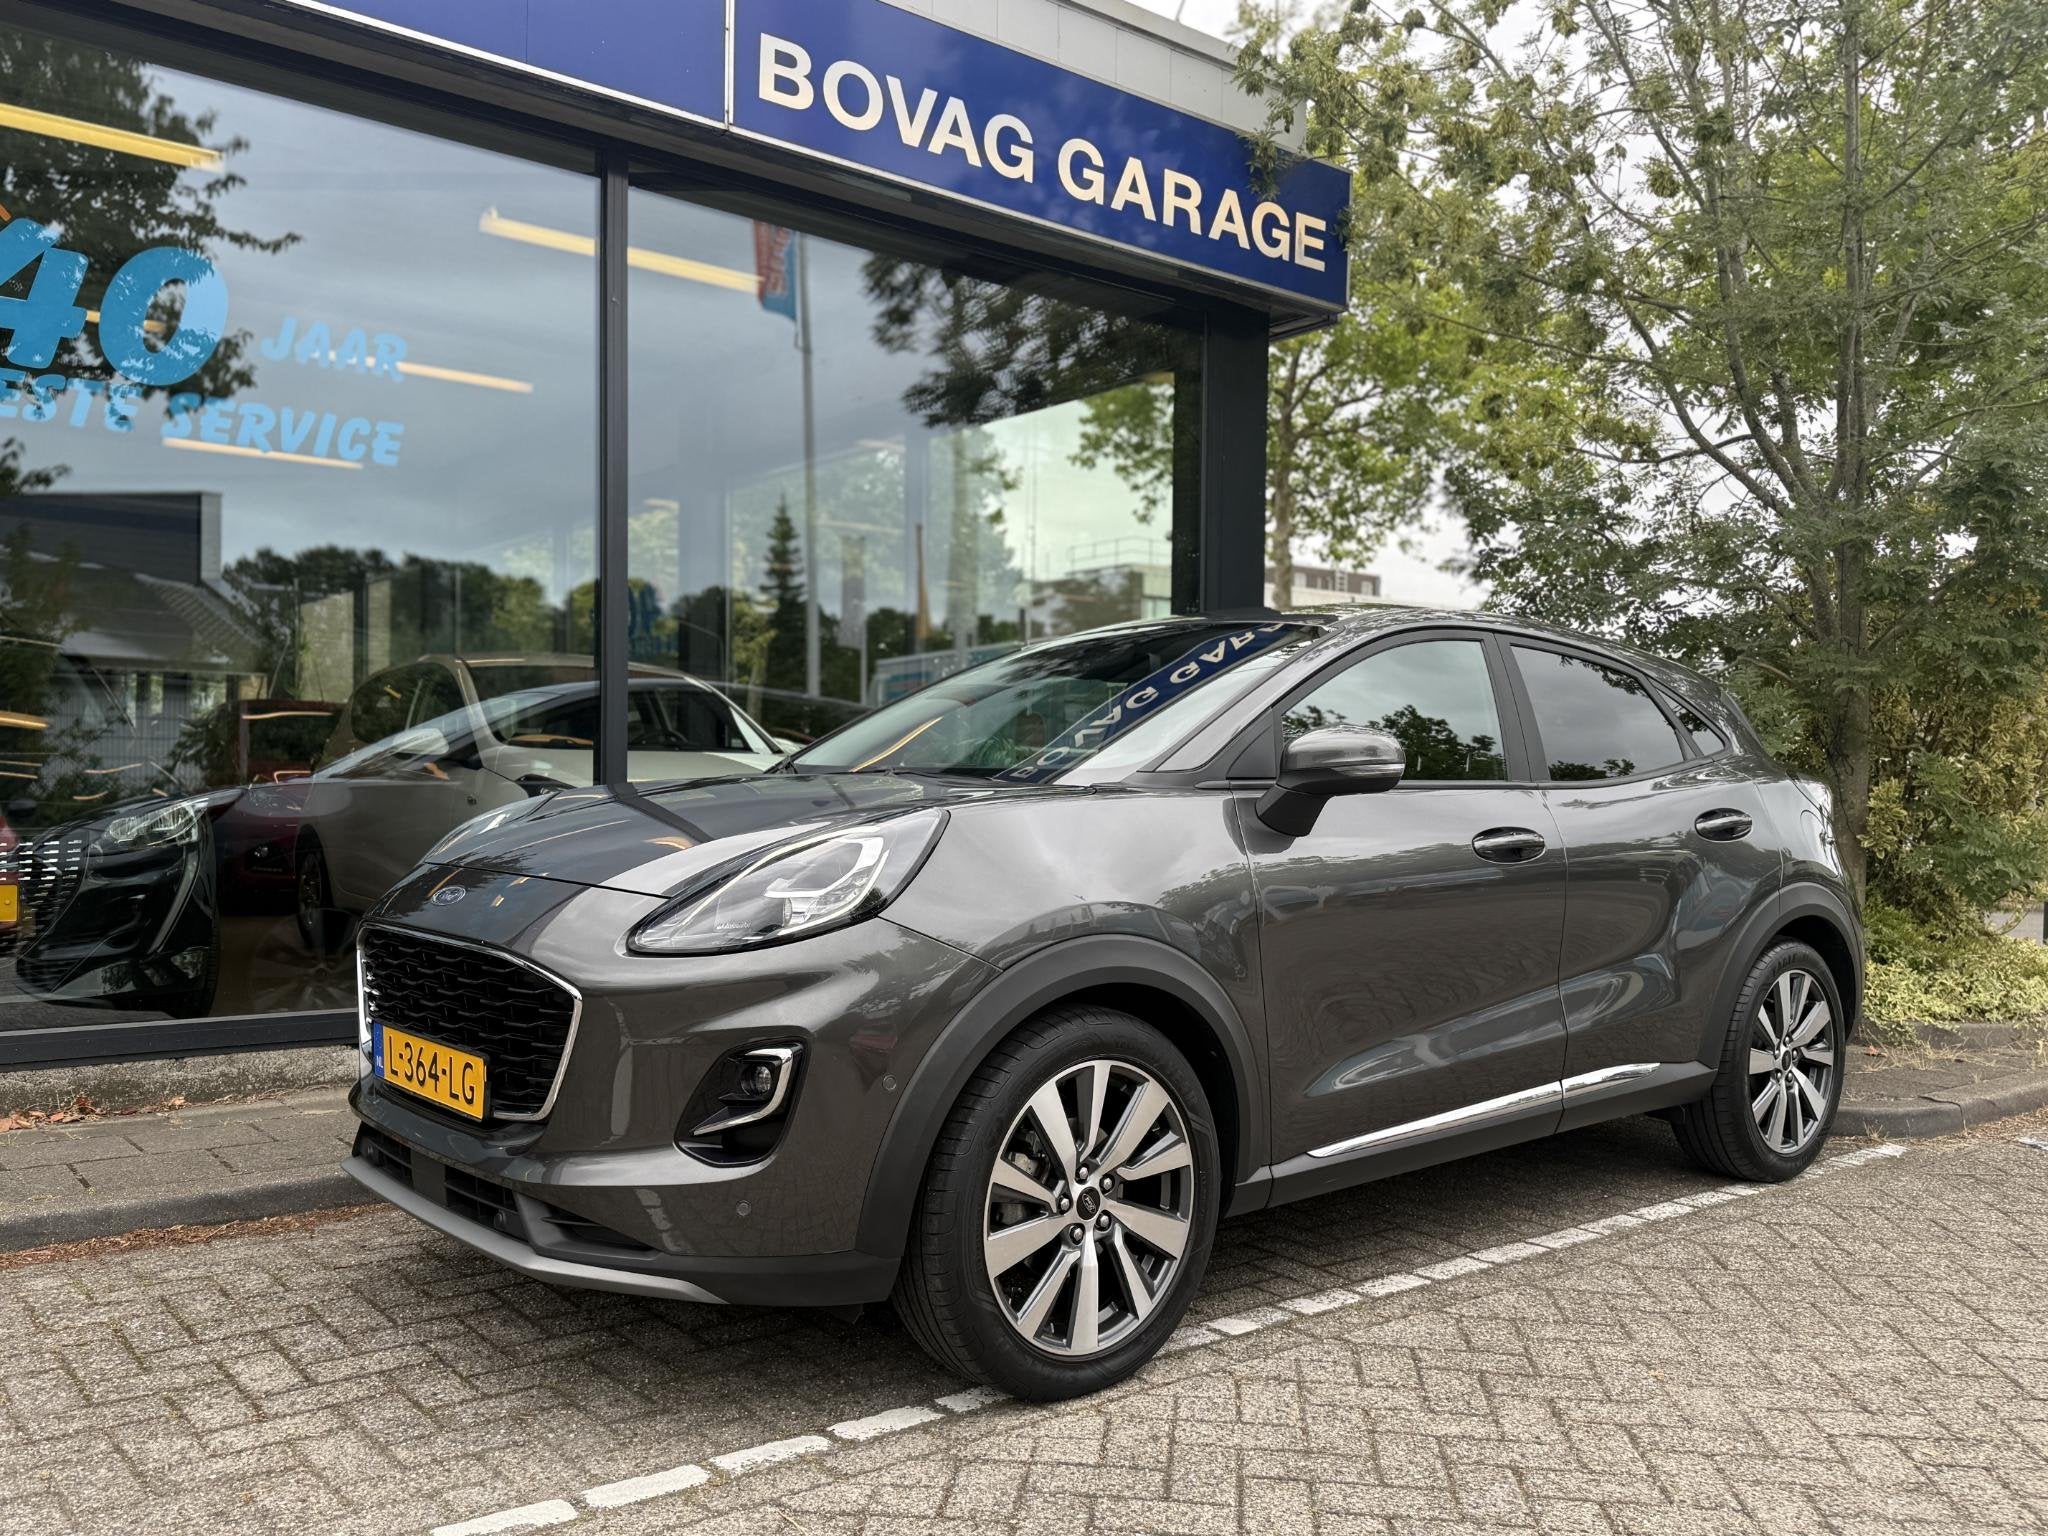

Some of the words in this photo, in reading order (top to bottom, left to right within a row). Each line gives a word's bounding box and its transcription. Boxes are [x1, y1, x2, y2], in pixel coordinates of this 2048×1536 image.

[759, 32, 1034, 184] BOVAG
[1057, 138, 1327, 273] GARAGE
[0, 217, 229, 386] 40
[260, 315, 408, 382] JAAR
[160, 391, 404, 467] SERVICE
[388, 1035, 476, 1106] L-364-LG
